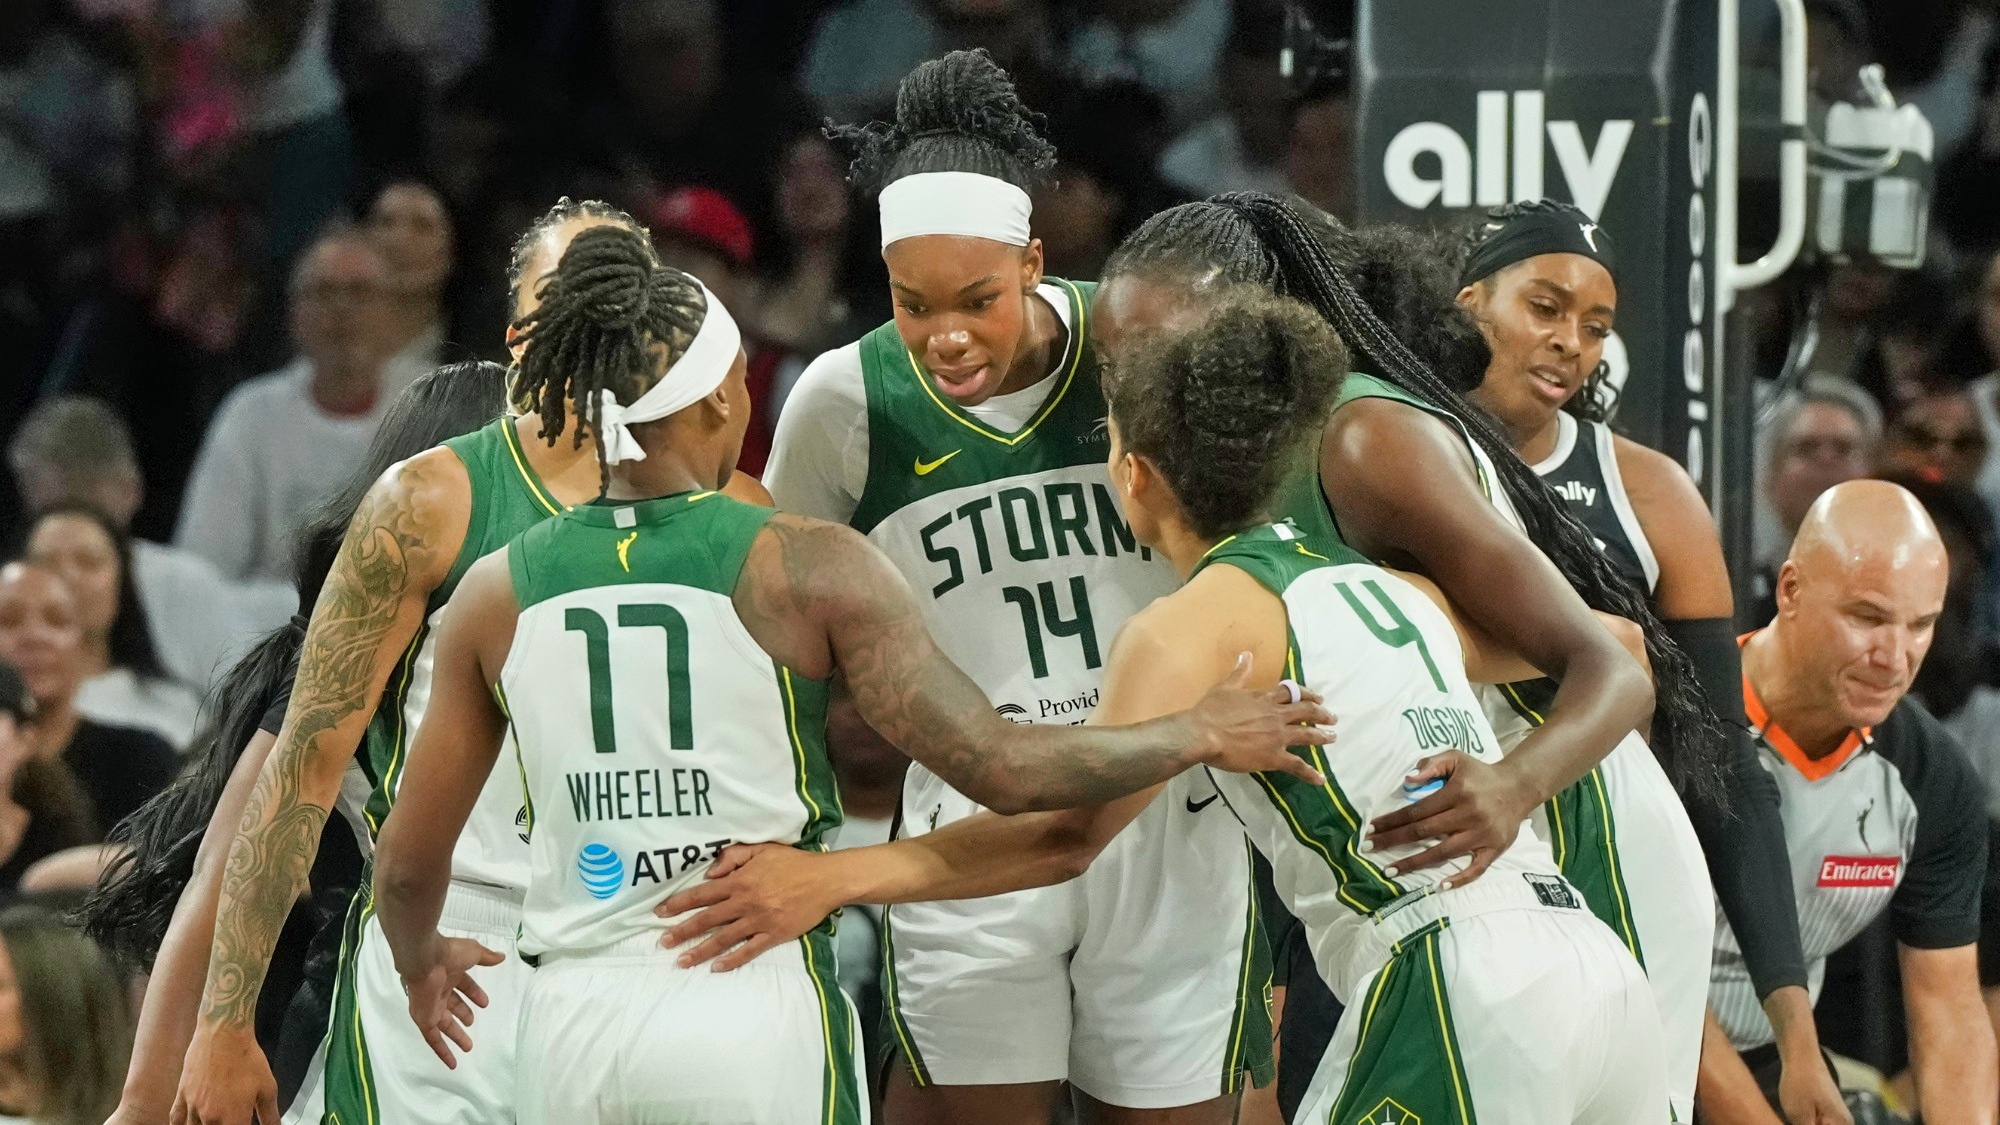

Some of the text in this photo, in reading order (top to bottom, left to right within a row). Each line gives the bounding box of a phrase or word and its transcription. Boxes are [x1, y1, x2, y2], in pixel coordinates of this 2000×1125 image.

[1384, 90, 1634, 223] ally
[1683, 92, 1712, 485] Google
[564, 603, 694, 753] 17
[1002, 575, 1102, 679] 14
[1332, 580, 1448, 693] 4
[1039, 688, 1100, 718] Provid
[1402, 706, 1484, 754] DIGGINS
[566, 768, 713, 823] WHEELER
[1821, 860, 1897, 881] Emirates
